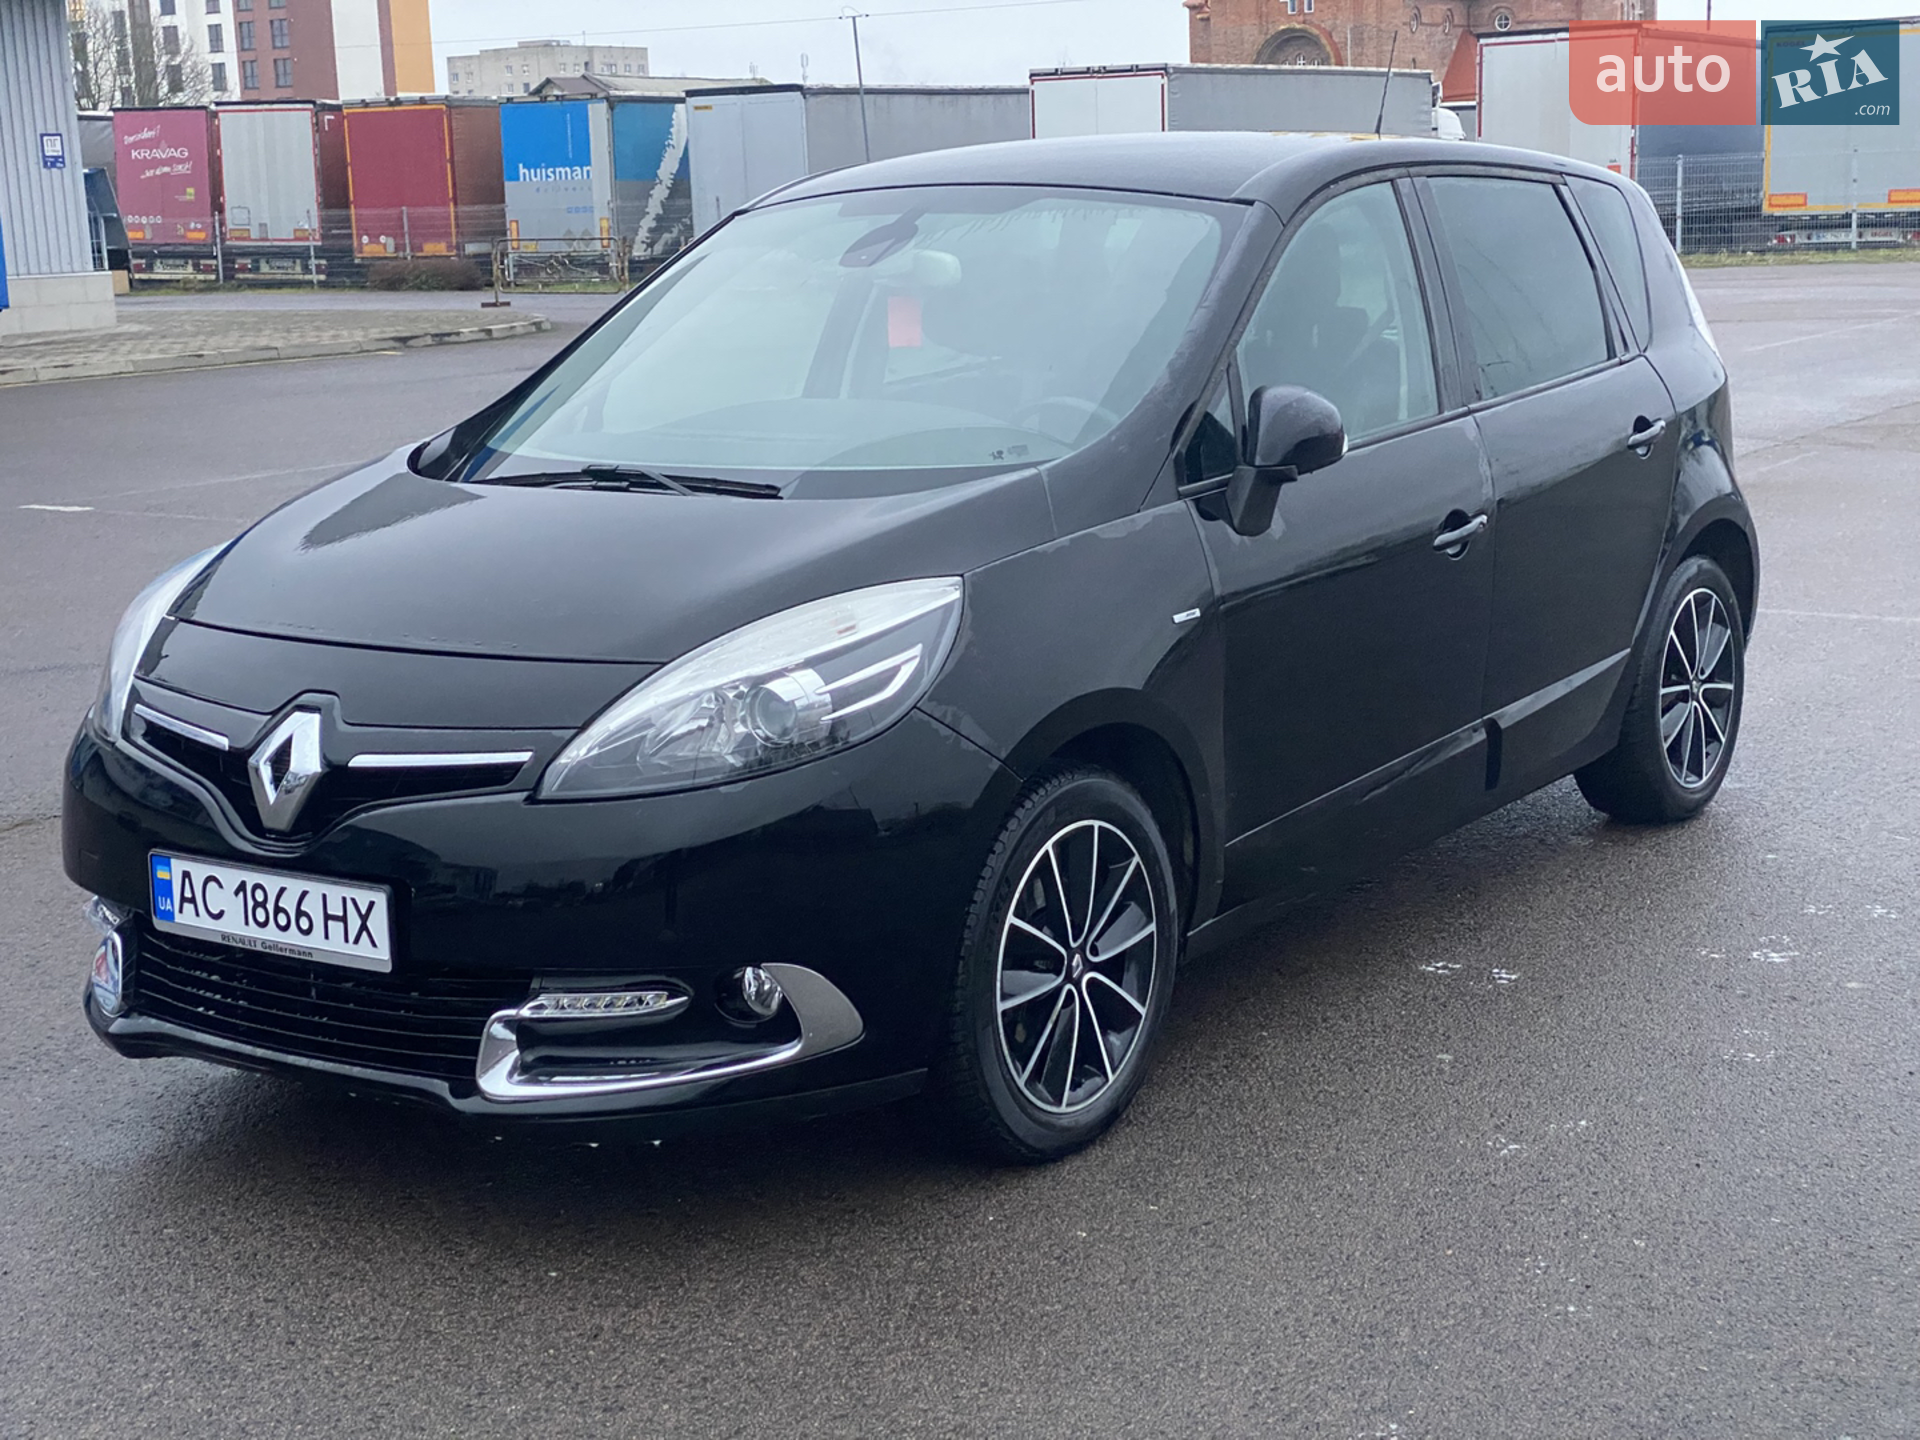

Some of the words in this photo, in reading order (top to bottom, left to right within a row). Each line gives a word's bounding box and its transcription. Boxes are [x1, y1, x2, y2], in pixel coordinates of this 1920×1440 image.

[131, 147, 189, 160] KRAVAG
[518, 163, 592, 182] huisman
[158, 895, 173, 912] UA
[178, 869, 226, 922] AC
[233, 879, 314, 937] 1866
[321, 892, 379, 949] HX
[221, 934, 257, 949] RENAULT
